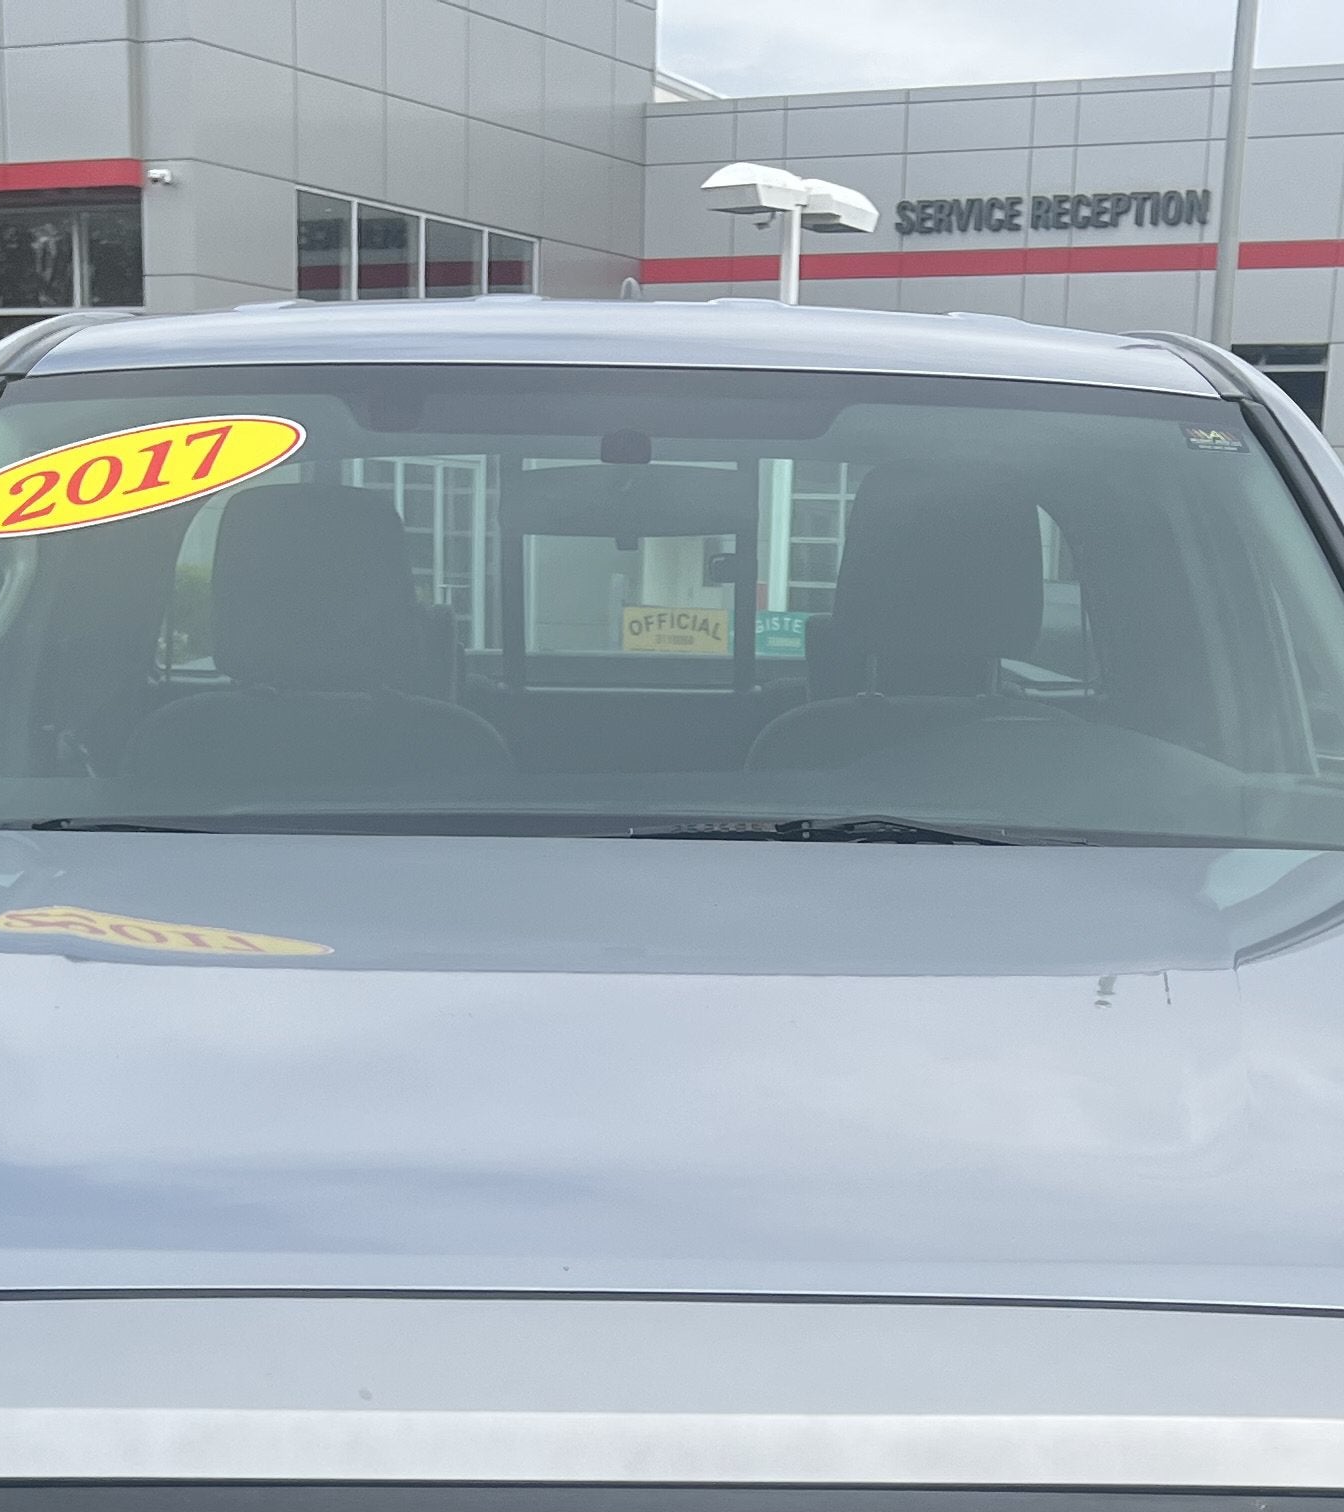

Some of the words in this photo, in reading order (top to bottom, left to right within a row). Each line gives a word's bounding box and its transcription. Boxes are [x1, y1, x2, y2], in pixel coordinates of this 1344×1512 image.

[895, 196, 1023, 235] SERVICE
[1030, 189, 1212, 231] RECEPTION
[1, 425, 233, 527] 2017
[628, 612, 722, 641] OFFICIAL
